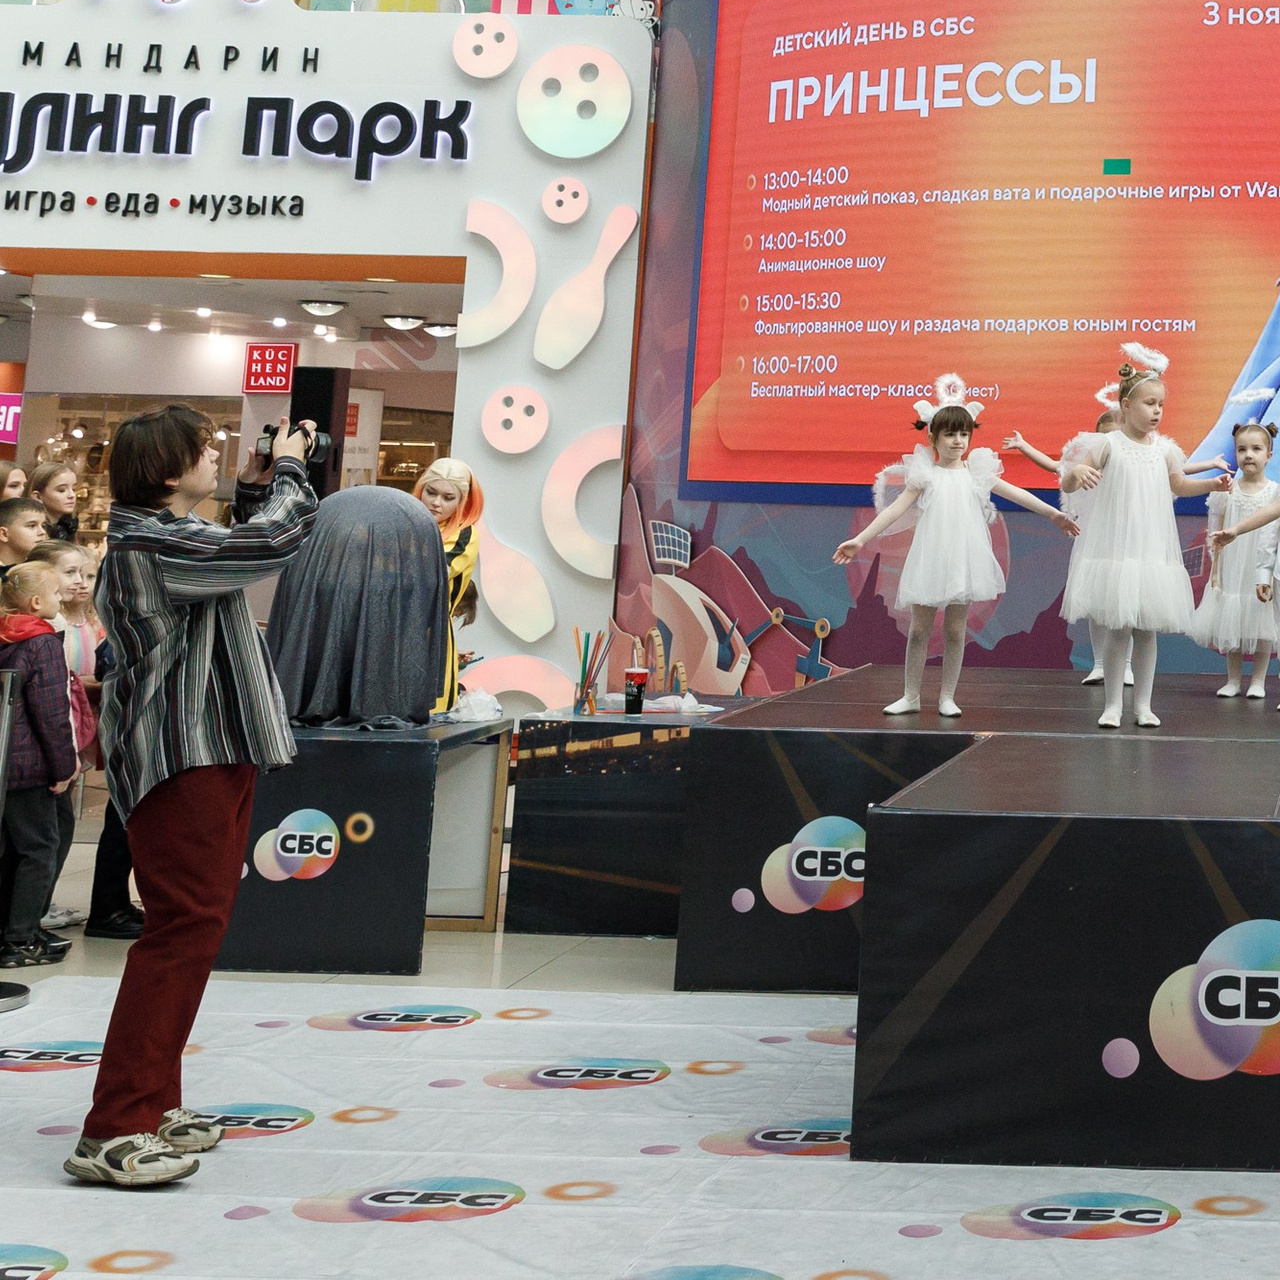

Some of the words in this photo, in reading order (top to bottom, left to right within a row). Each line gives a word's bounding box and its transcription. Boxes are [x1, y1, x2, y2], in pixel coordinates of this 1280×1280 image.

[1203, 1, 1220, 26] 3
[772, 22, 852, 58] ДЕТСКИЙ
[853, 19, 908, 48] ДЕНЬ
[913, 19, 926, 39] В
[929, 16, 976, 35] СБС
[22, 40, 320, 74] МАНДАРИН
[768, 58, 1098, 123] ПРИНЦЕССЫ
[242, 96, 472, 181] парк
[763, 166, 849, 190] 13:00-14:00
[4, 189, 76, 218] игра
[104, 191, 160, 218] еда
[188, 193, 305, 222] музыка
[762, 194, 811, 213] Модный
[813, 190, 868, 210] детский
[872, 189, 919, 206] показ,
[922, 188, 989, 203] сладкая
[993, 187, 1030, 201] вата
[1035, 188, 1046, 200] и
[1050, 185, 1165, 202] подарочные
[1168, 184, 1215, 202] игры
[1219, 184, 1241, 198] от
[760, 228, 847, 251] 14:00-15:00
[758, 256, 854, 273] Анимационное
[856, 256, 886, 271] шоу
[756, 291, 841, 312] 15:00-15:30
[754, 319, 864, 337] Фольгированное
[867, 319, 898, 336] шоу
[901, 320, 910, 331] и
[913, 319, 980, 335] раздача
[984, 319, 1069, 334] подарков
[1073, 318, 1127, 331] юным
[1132, 318, 1196, 332] гостям
[253, 349, 288, 361] KÜC
[752, 355, 838, 374] 16:00-17:00
[251, 363, 287, 373] HEN
[250, 376, 286, 386] LAND
[750, 381, 826, 398] Бесплатный
[828, 383, 933, 400] мастер-класс
[279, 833, 334, 856] СБС
[794, 849, 866, 879] СБС
[362, 1012, 473, 1026] СБС
[0, 1048, 102, 1063] СБС
[542, 1067, 657, 1081] СБС
[760, 1130, 851, 1142] СБ
[367, 1189, 510, 1208] СБС
[1026, 1206, 1164, 1224] СБС
